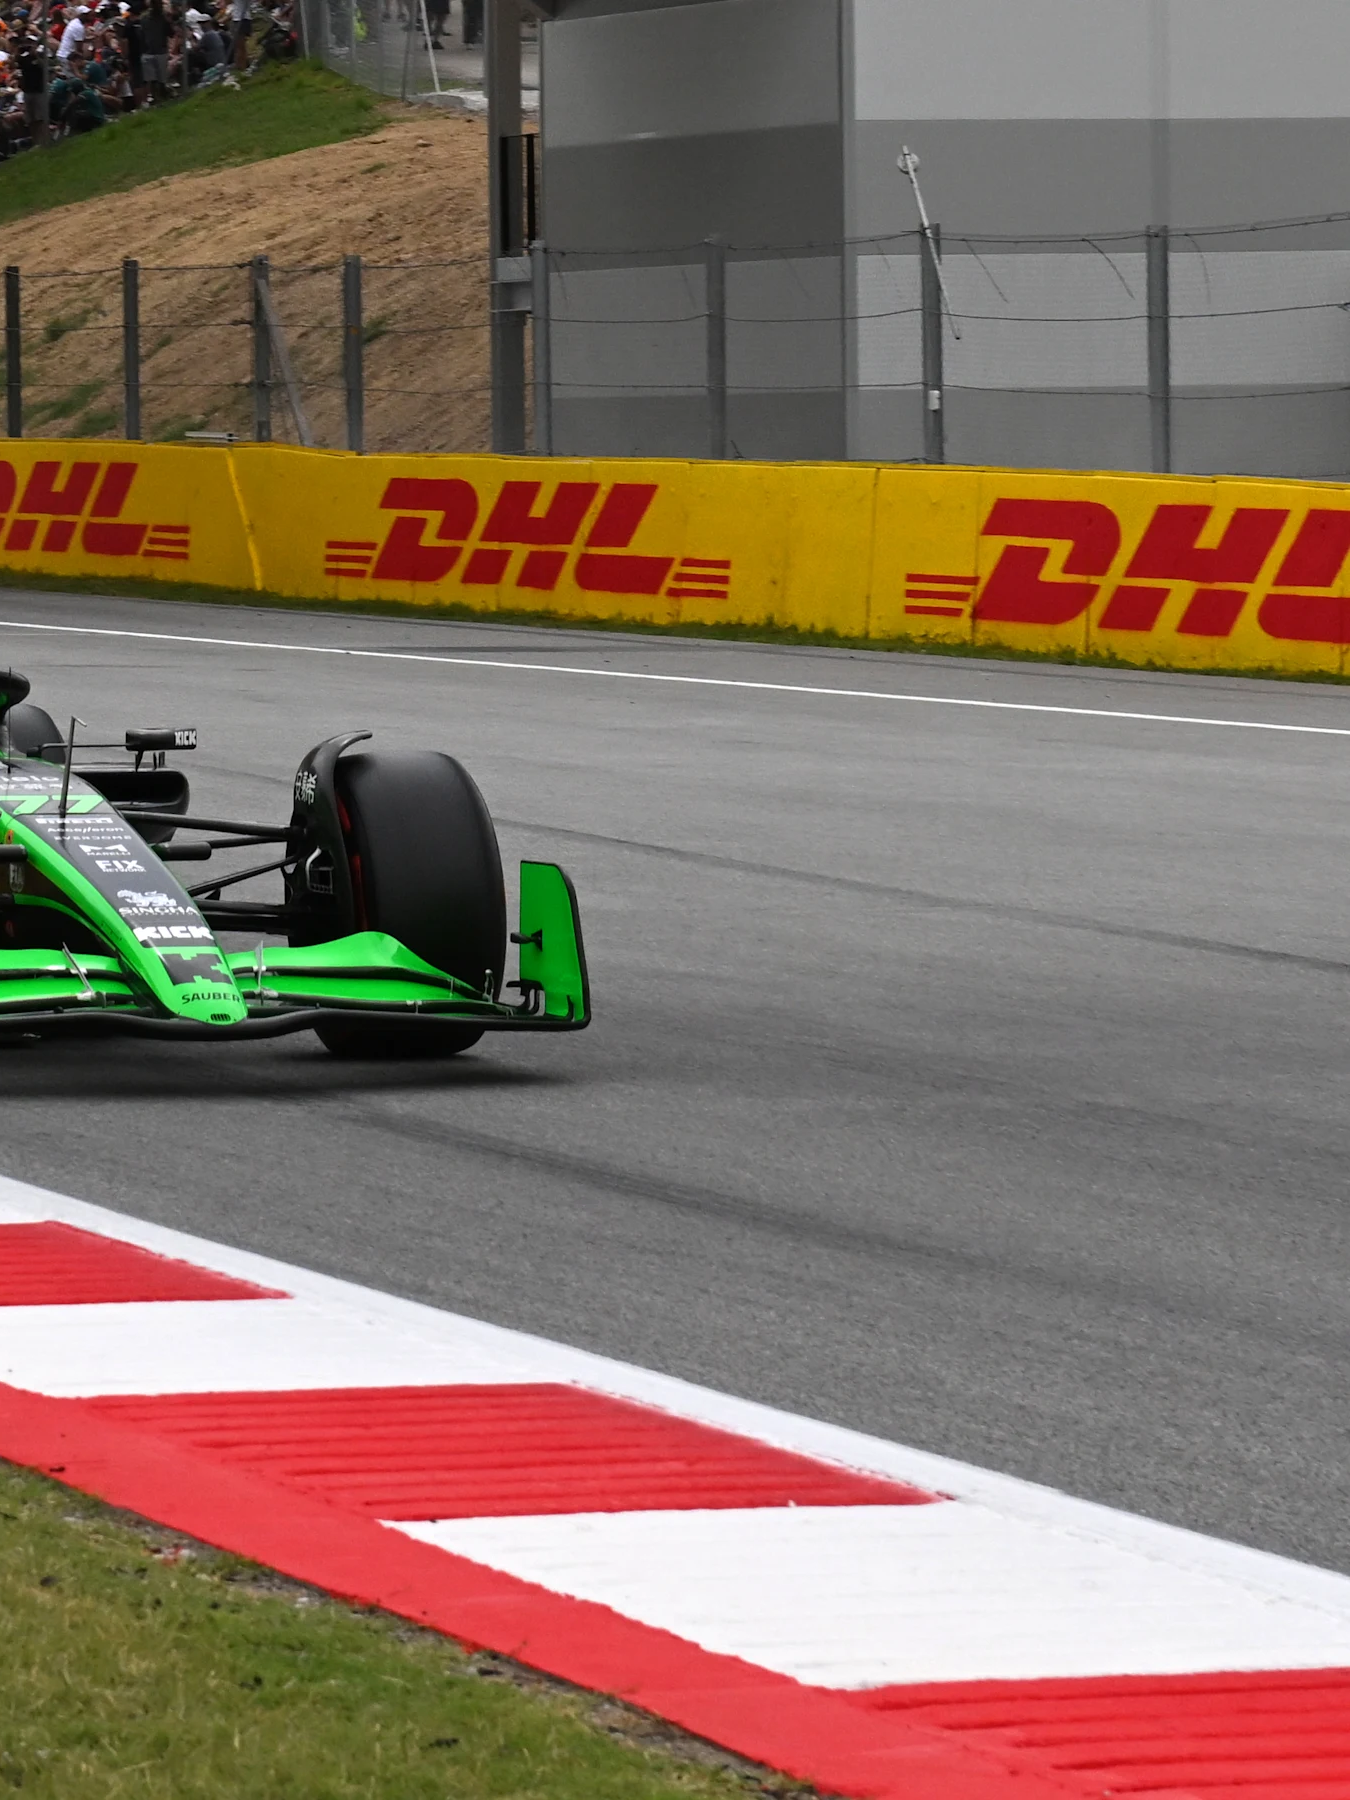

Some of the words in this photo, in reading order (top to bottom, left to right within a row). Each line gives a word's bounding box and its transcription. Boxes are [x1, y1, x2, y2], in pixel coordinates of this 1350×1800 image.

[373, 477, 676, 596] DHL
[971, 498, 1350, 645] DHL
[174, 730, 197, 747] KICK
[95, 859, 145, 870] FIX
[118, 906, 201, 917] SINGHA
[133, 925, 215, 942] KICK
[181, 991, 241, 1005] SAUBER
